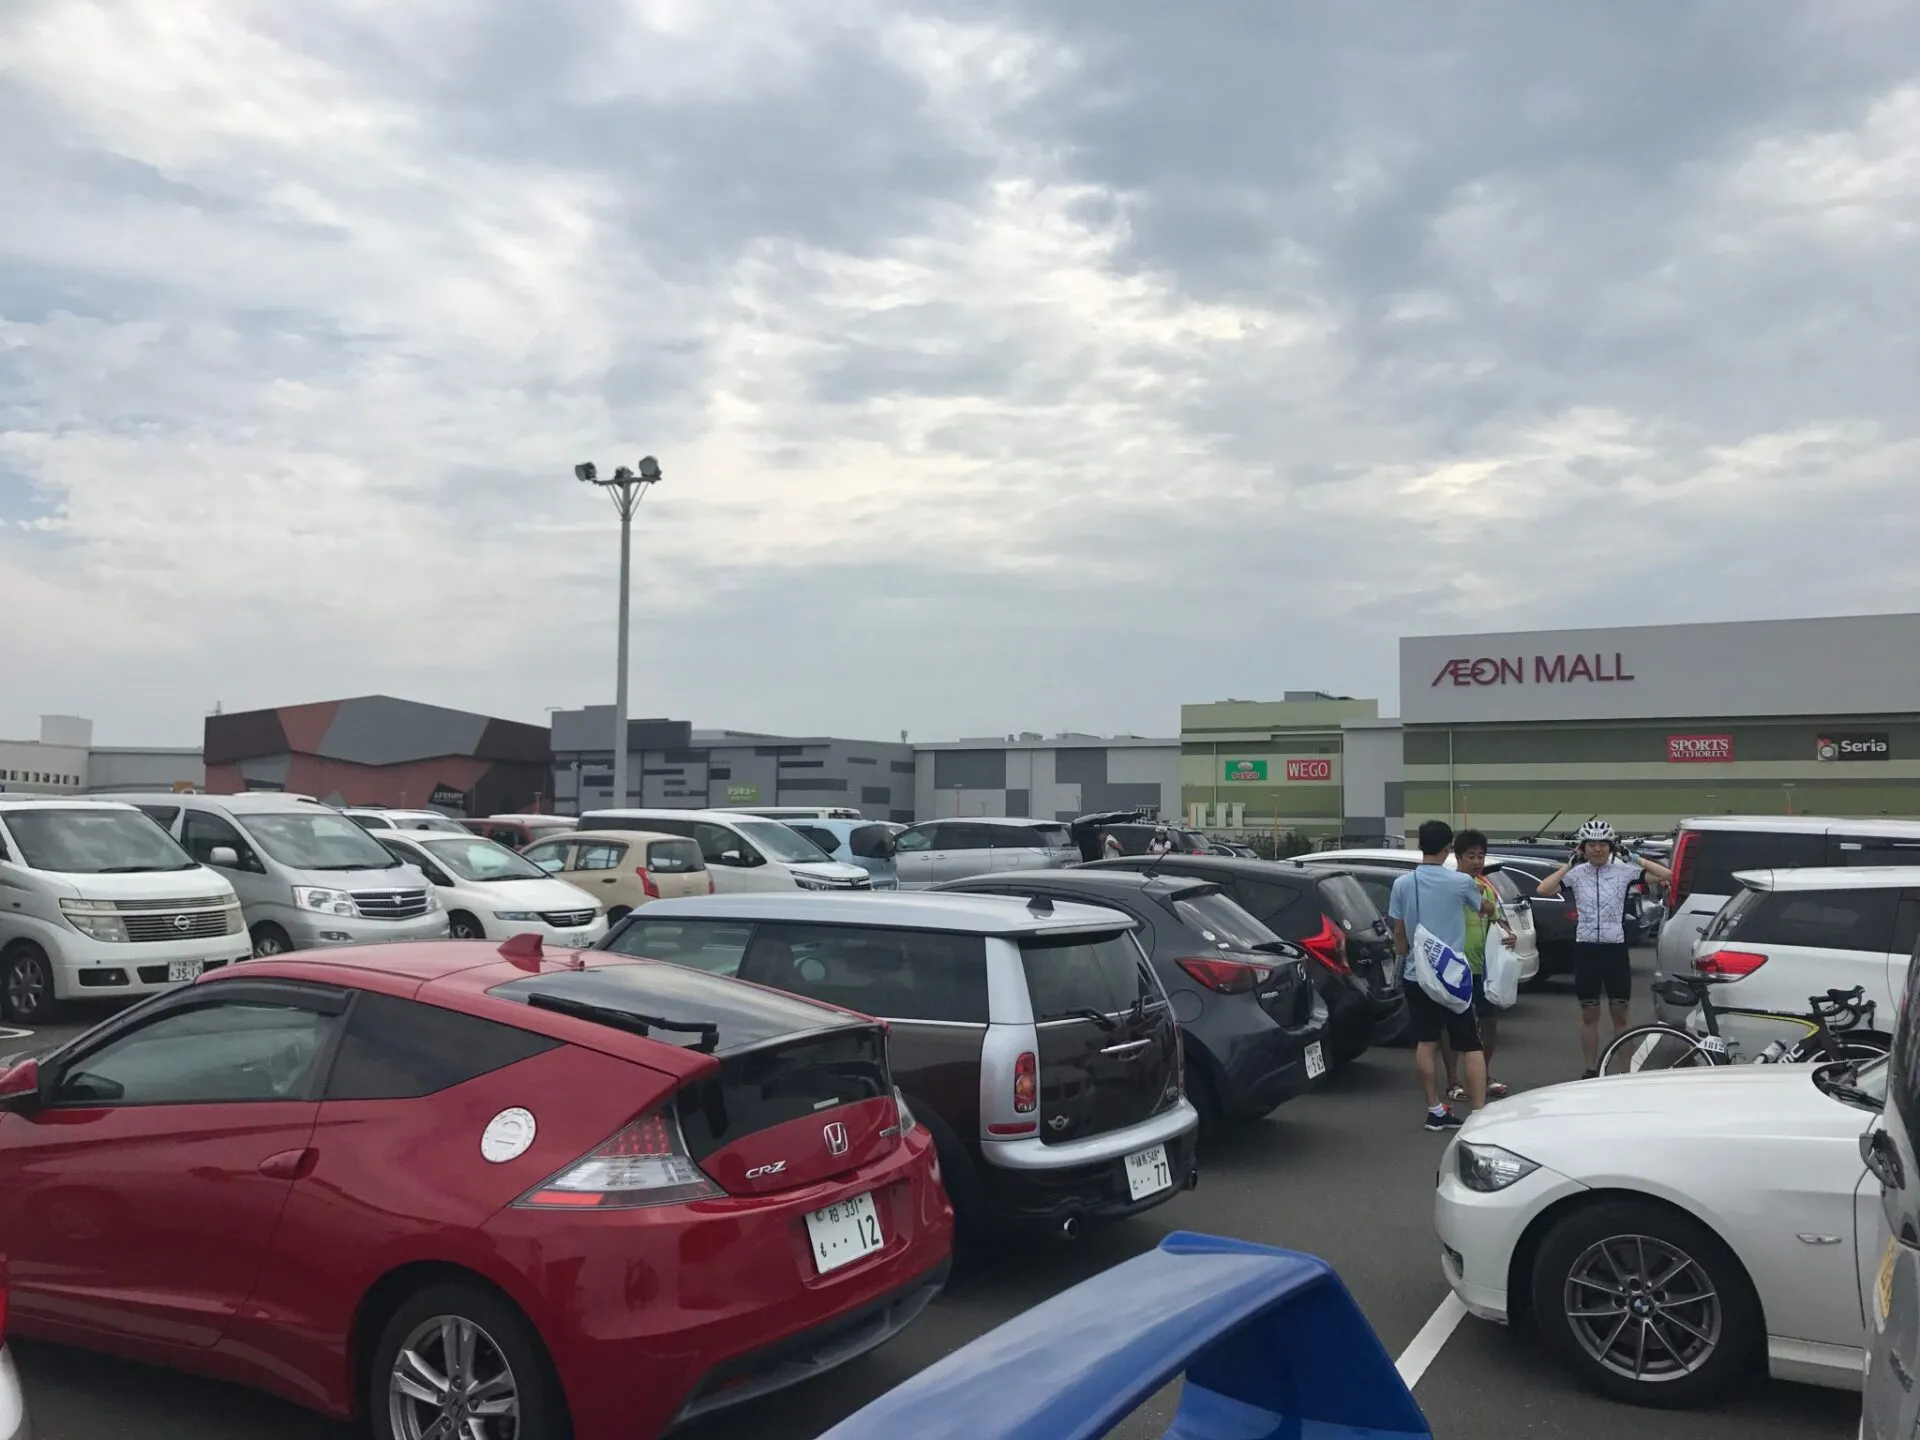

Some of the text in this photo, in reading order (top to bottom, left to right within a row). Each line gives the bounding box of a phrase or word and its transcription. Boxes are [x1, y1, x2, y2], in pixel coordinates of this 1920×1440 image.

[1534, 652, 1635, 684] MALL
[1670, 739, 1729, 751] SPORTS
[1840, 738, 1888, 753] Seria
[1288, 762, 1329, 777] WEGO
[1153, 1160, 1168, 1187] 77
[827, 1199, 860, 1225] 柏 331
[856, 1213, 880, 1250] 12
